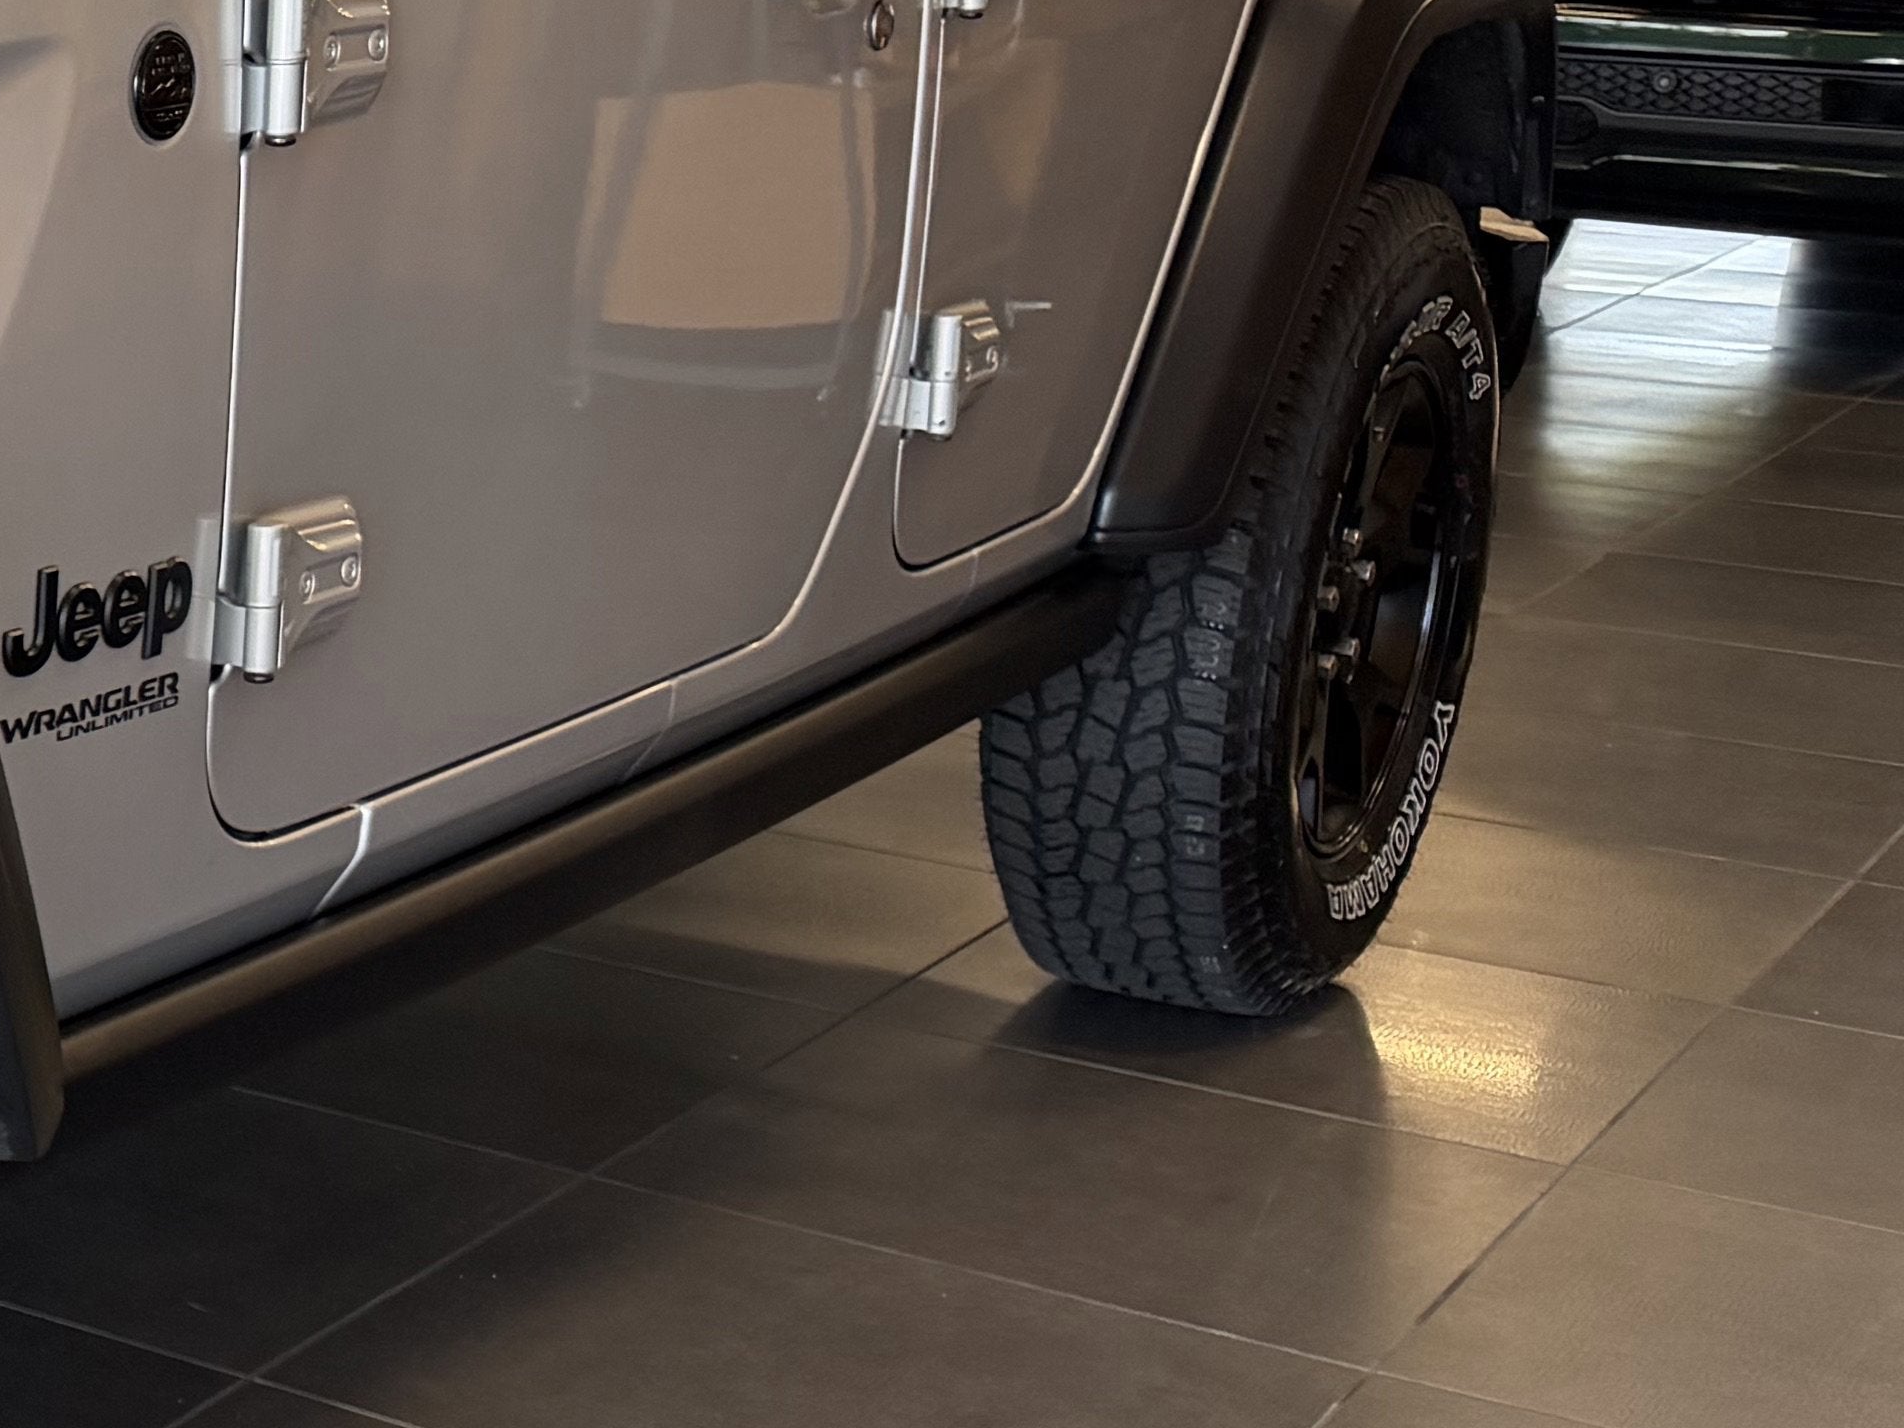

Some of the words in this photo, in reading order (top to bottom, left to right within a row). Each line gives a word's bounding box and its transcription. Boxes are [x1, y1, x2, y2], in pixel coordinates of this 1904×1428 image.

[1, 555, 193, 678] Jeep
[56, 695, 180, 742] UNLIMITED
[1326, 700, 1456, 920] YOKOHAMA
